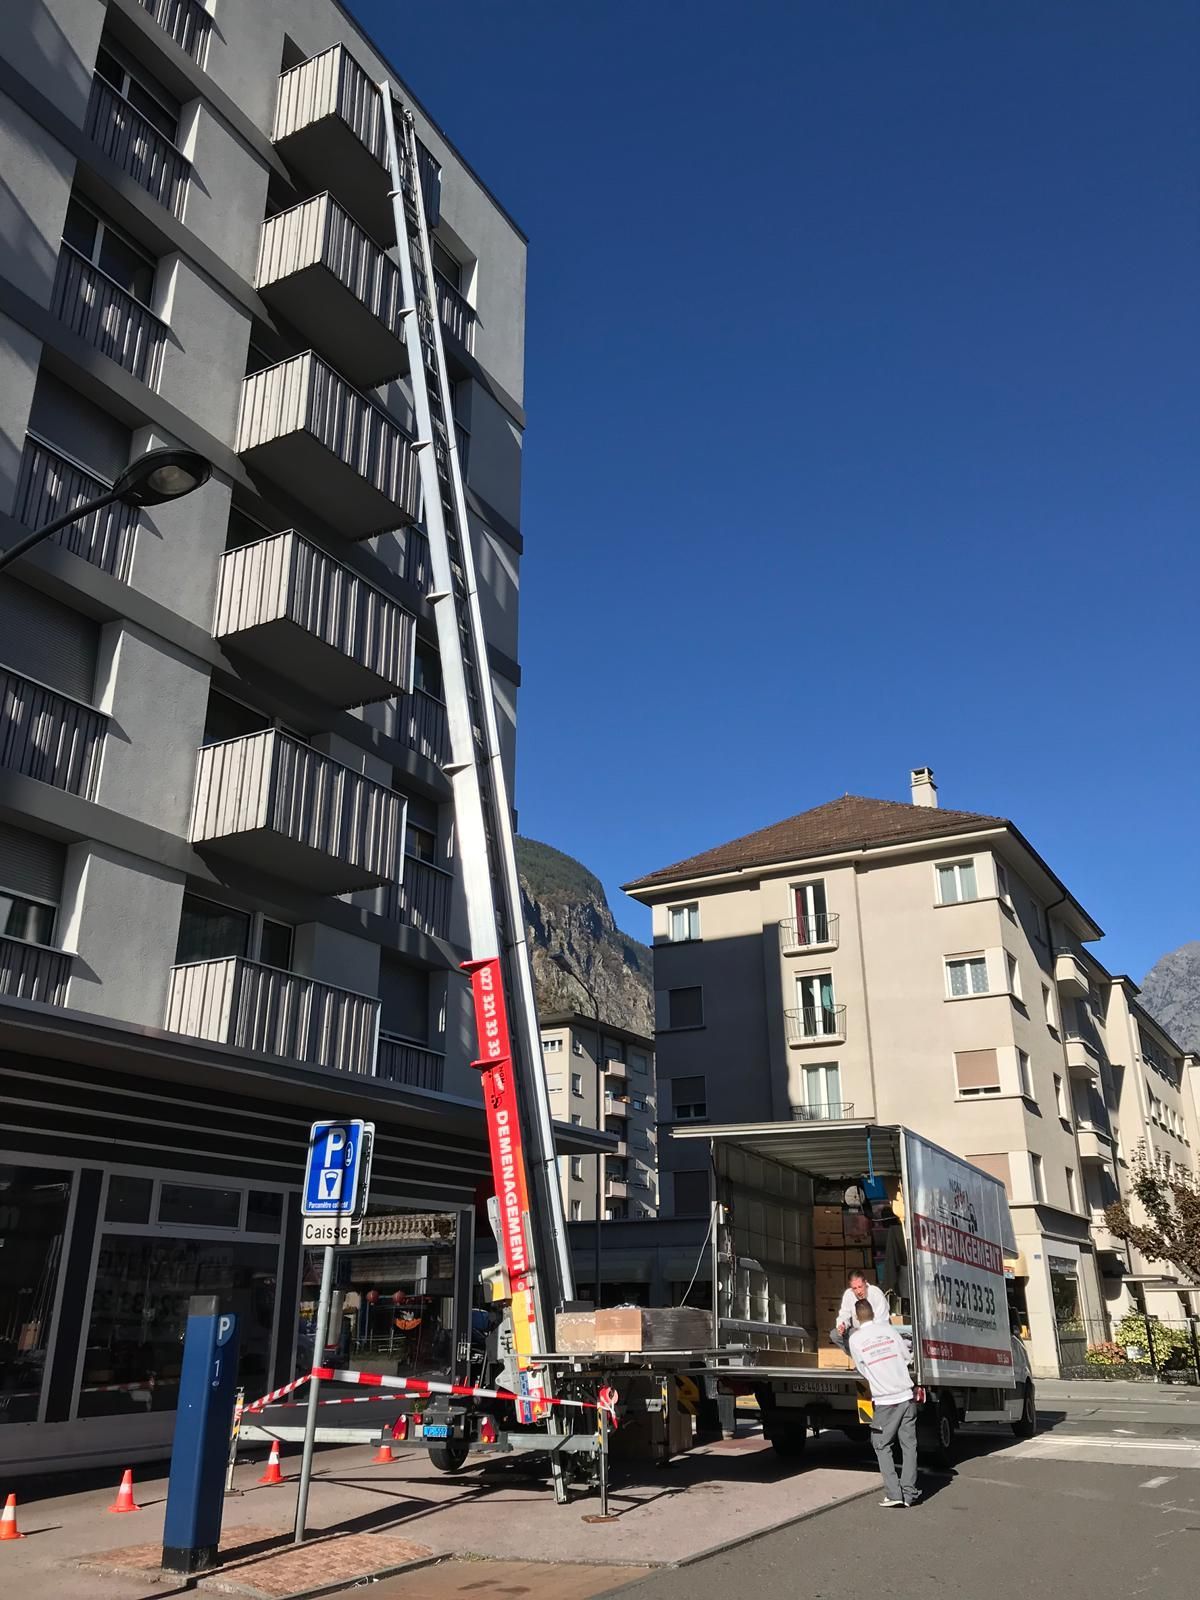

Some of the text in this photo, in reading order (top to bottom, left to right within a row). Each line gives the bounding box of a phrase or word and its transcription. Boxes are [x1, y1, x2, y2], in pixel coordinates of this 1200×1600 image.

[481, 967, 500, 1057] 027 321 33 33
[324, 1127, 346, 1168] P
[496, 1110, 525, 1271] DEMENAGEMENT
[305, 1224, 348, 1240] Caisse
[919, 1218, 1001, 1272] DEMENAGEMENT
[934, 1273, 995, 1316] 027 321 33 33
[219, 1317, 230, 1340] P
[214, 1360, 220, 1377] 1
